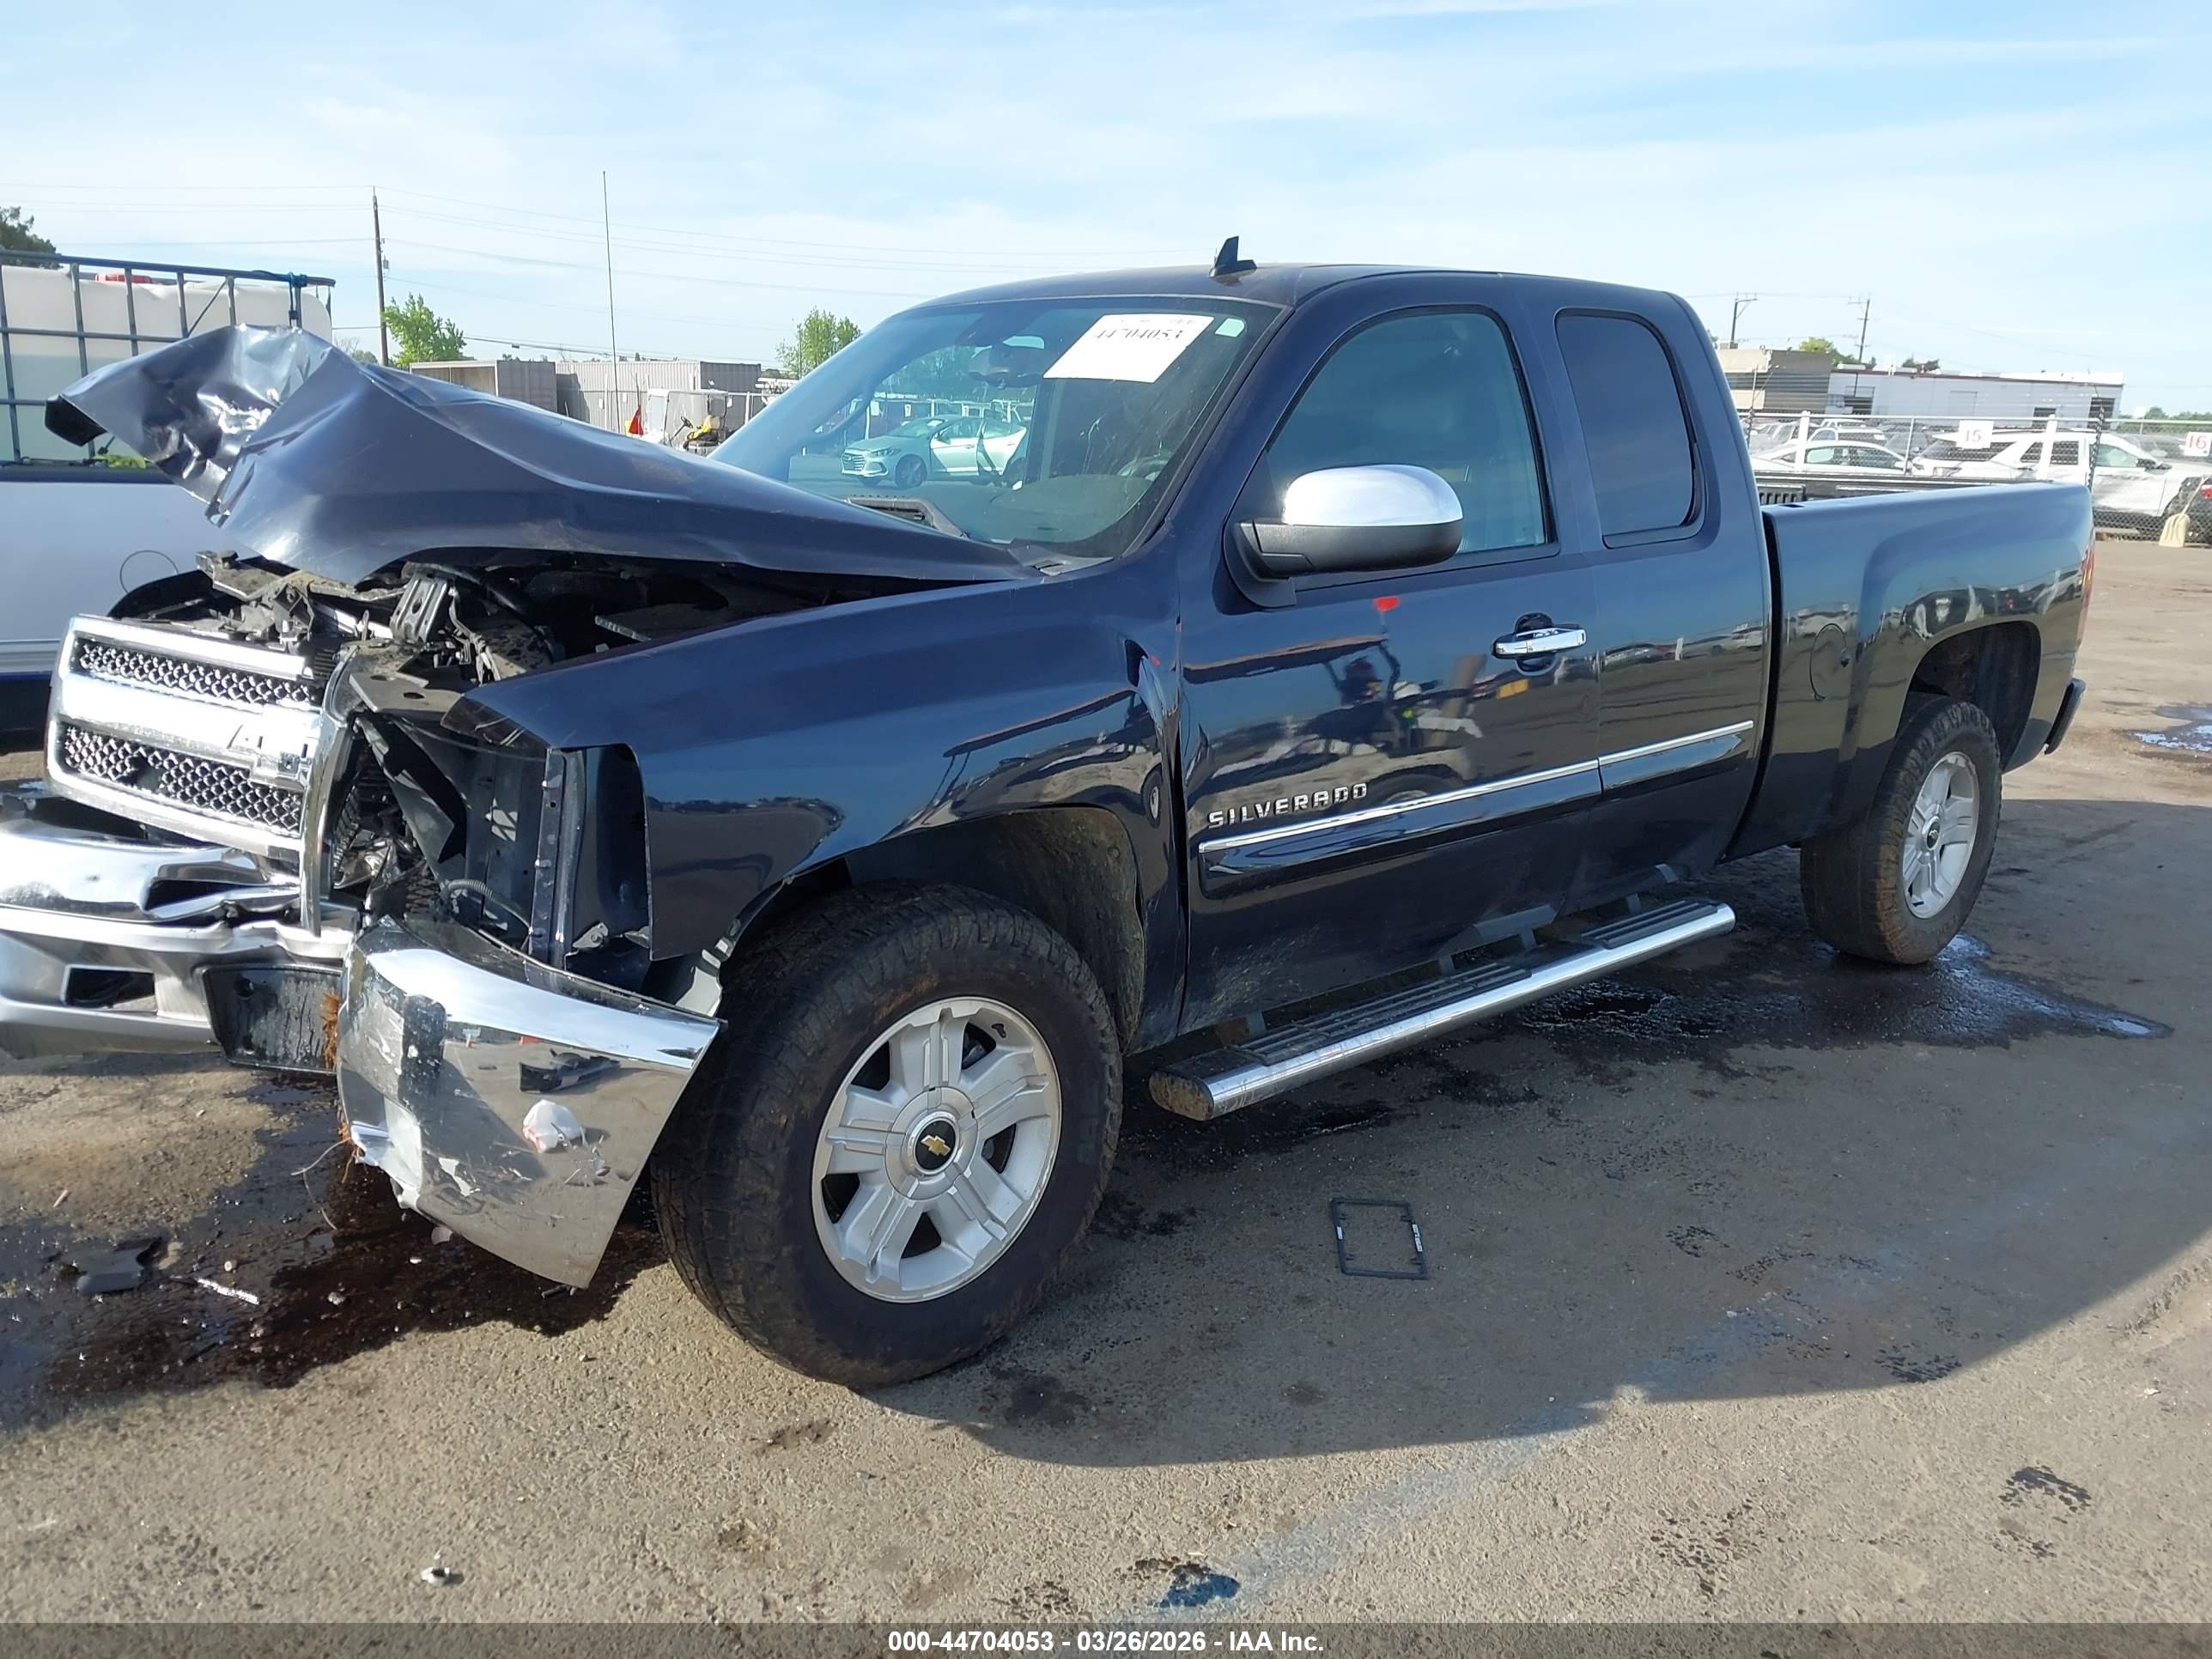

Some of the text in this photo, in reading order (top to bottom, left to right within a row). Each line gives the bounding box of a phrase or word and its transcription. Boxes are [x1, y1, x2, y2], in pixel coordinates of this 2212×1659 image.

[1966, 429, 1982, 442] 15
[2189, 434, 2208, 449] 16
[1207, 782, 1367, 829] SILVERADO
